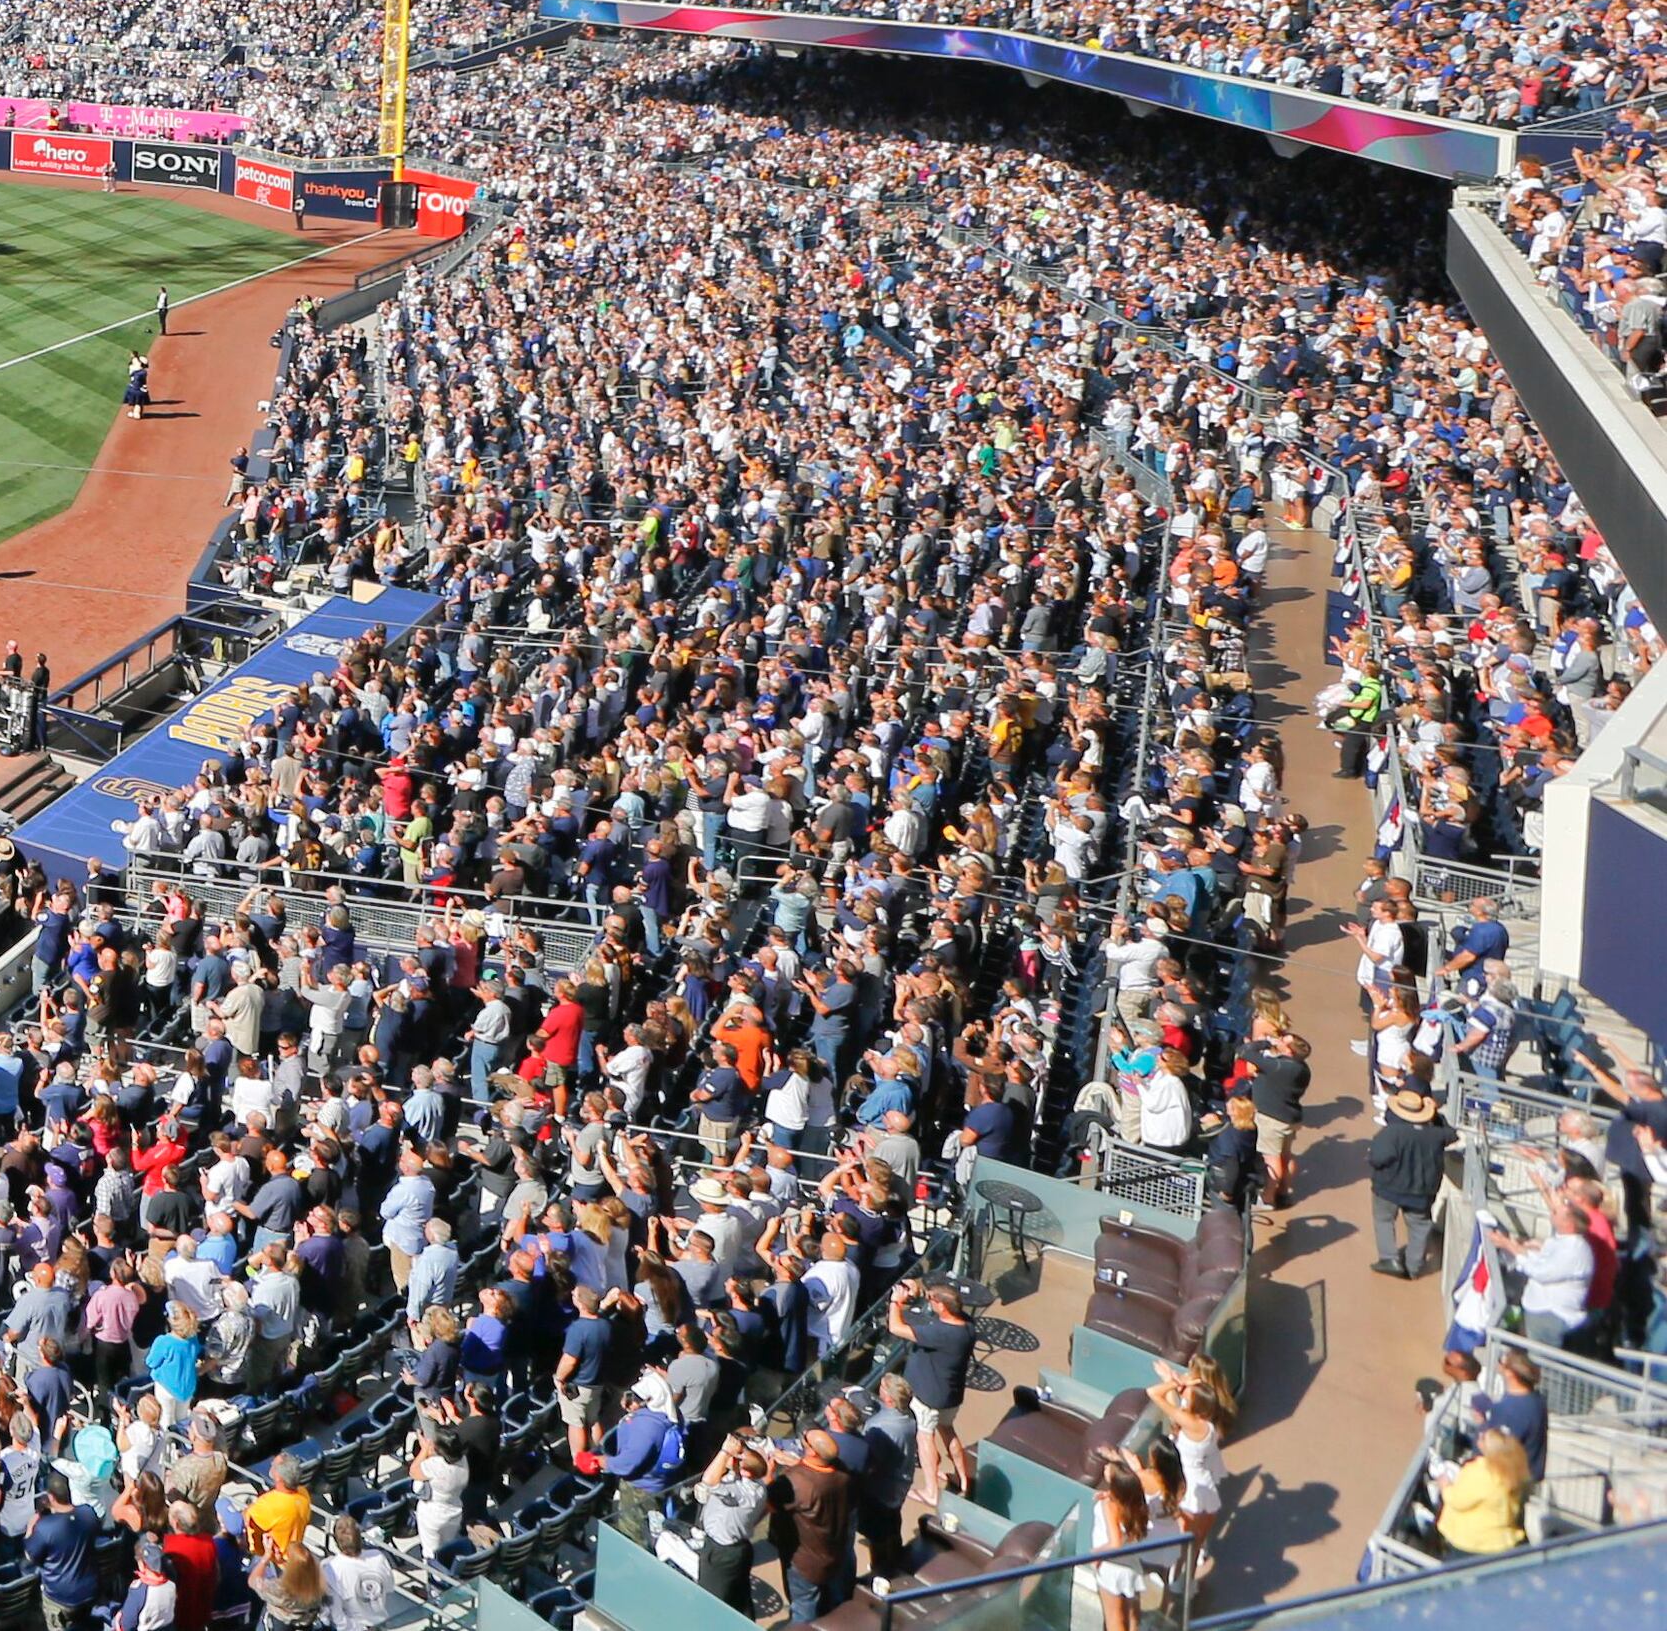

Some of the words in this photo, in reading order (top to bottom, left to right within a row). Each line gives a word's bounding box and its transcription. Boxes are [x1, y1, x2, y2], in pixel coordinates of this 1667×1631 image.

[46, 141, 87, 163] hero
[135, 150, 218, 176] SONY
[14, 157, 39, 167] Lower
[40, 158, 63, 171] utility
[64, 160, 80, 171] bills
[81, 162, 98, 172] for
[236, 165, 292, 191] petco.com
[344, 197, 364, 208] from
